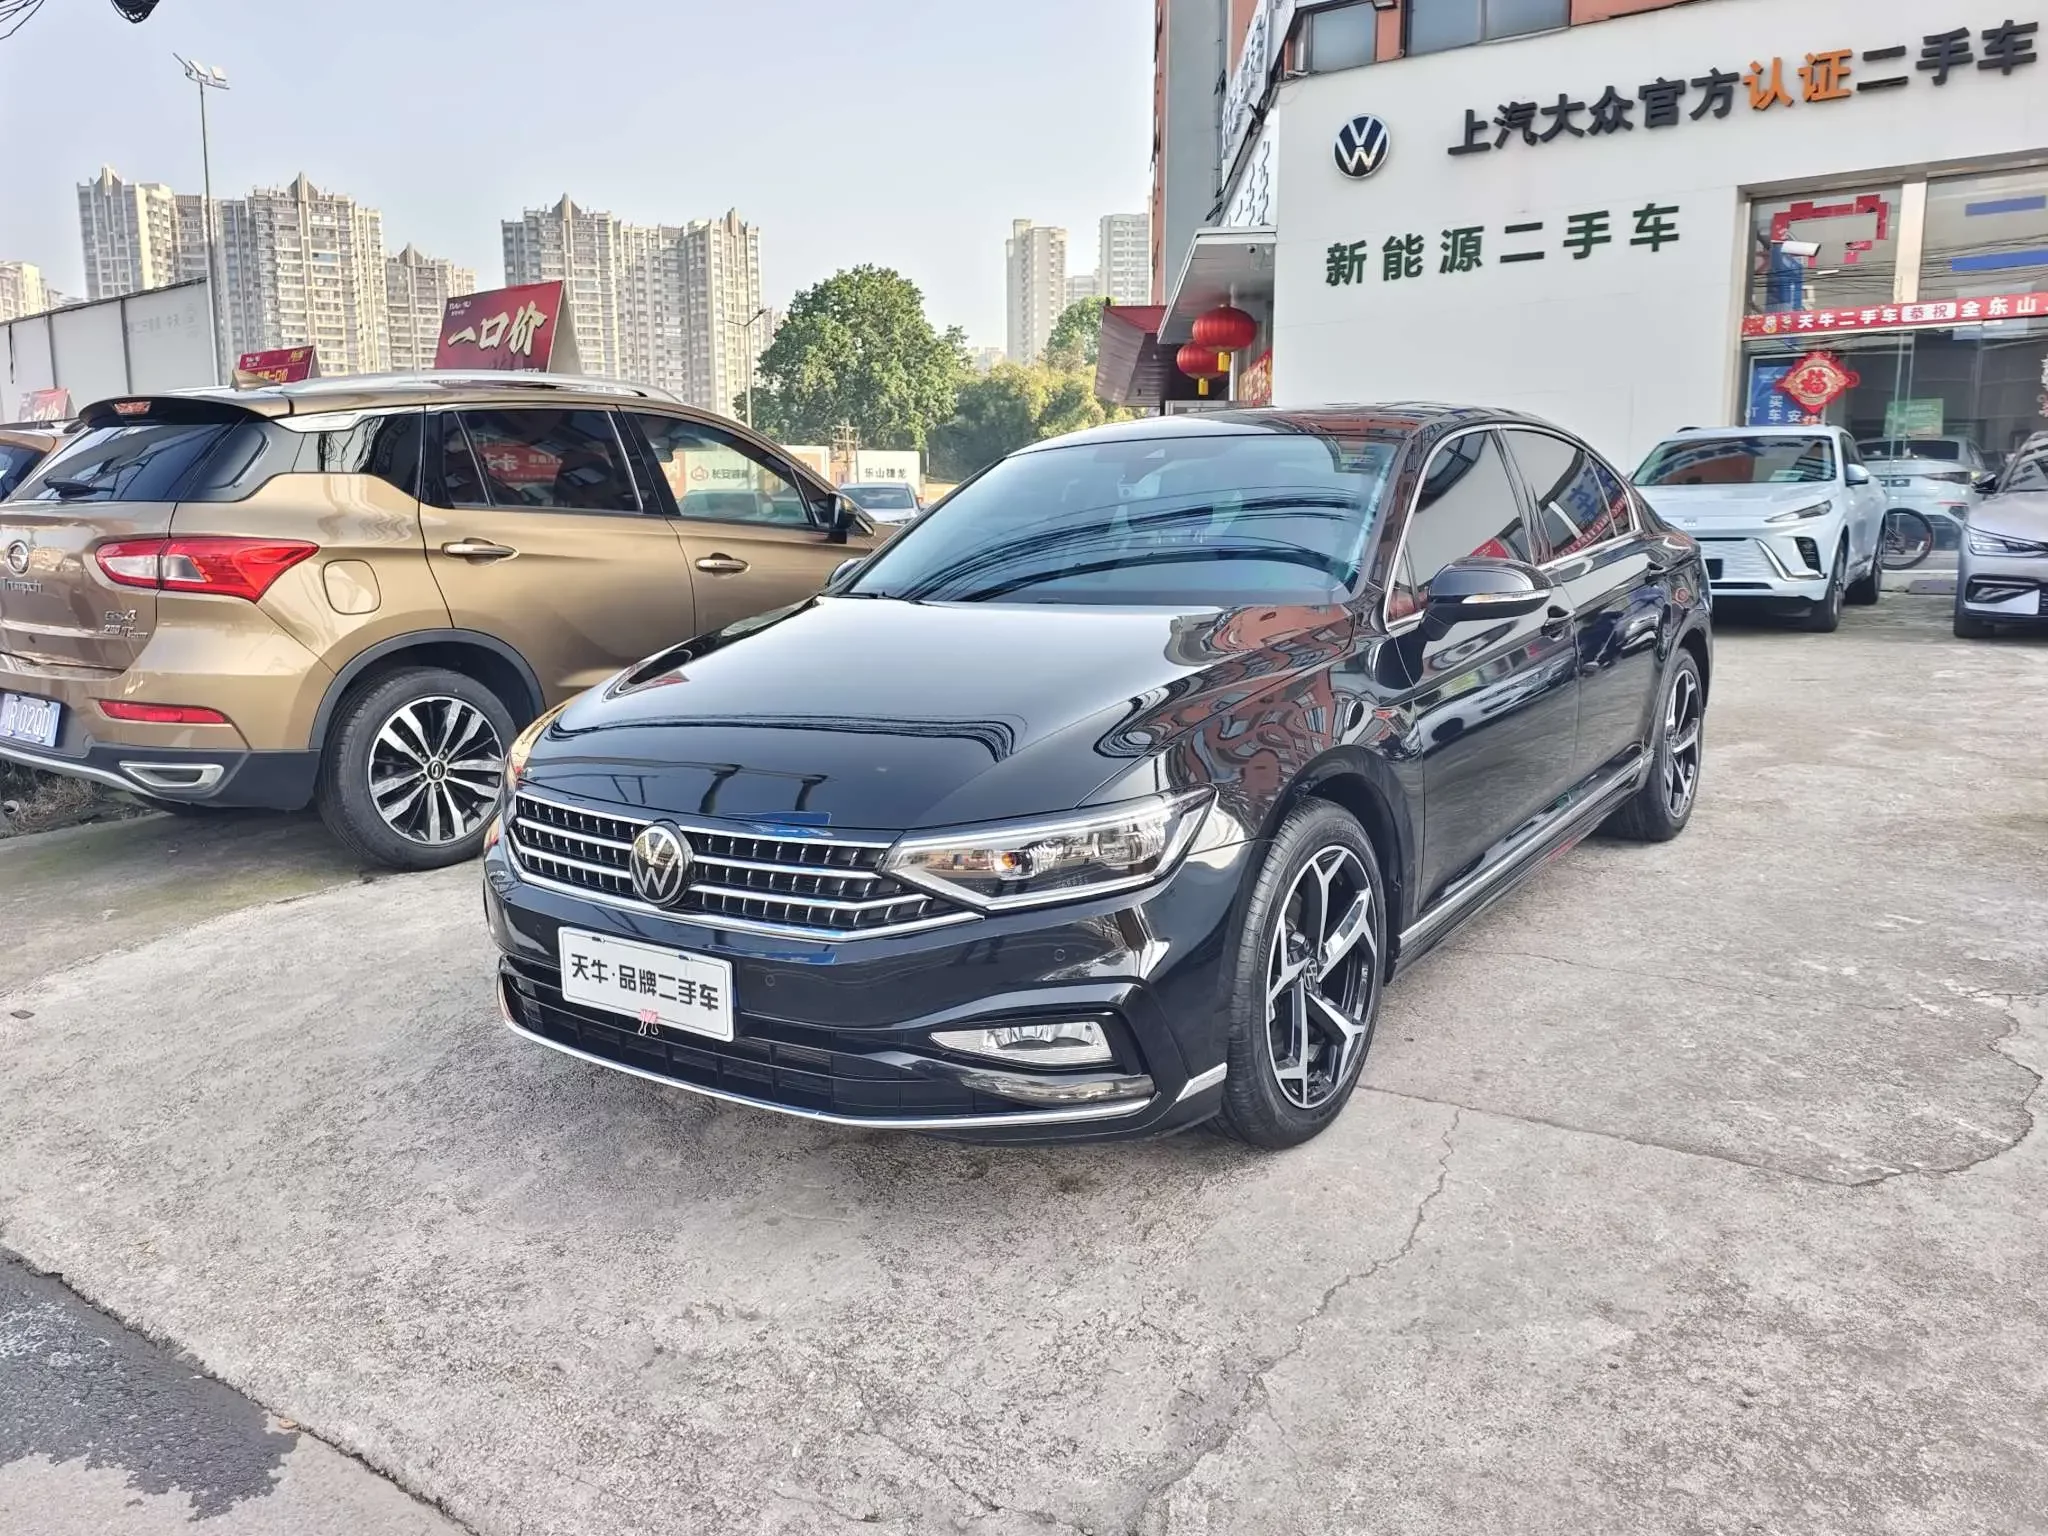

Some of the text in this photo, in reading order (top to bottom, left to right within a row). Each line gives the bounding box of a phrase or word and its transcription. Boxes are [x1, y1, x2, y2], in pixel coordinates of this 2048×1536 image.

[1447, 19, 2039, 156] 上汽大众官方认证二手车
[1325, 203, 1681, 287] 新能源二手车
[447, 301, 547, 356] 一口价
[1798, 308, 1899, 328] 天牛二手车
[571, 953, 718, 1010] 天牛·品牌二手车
